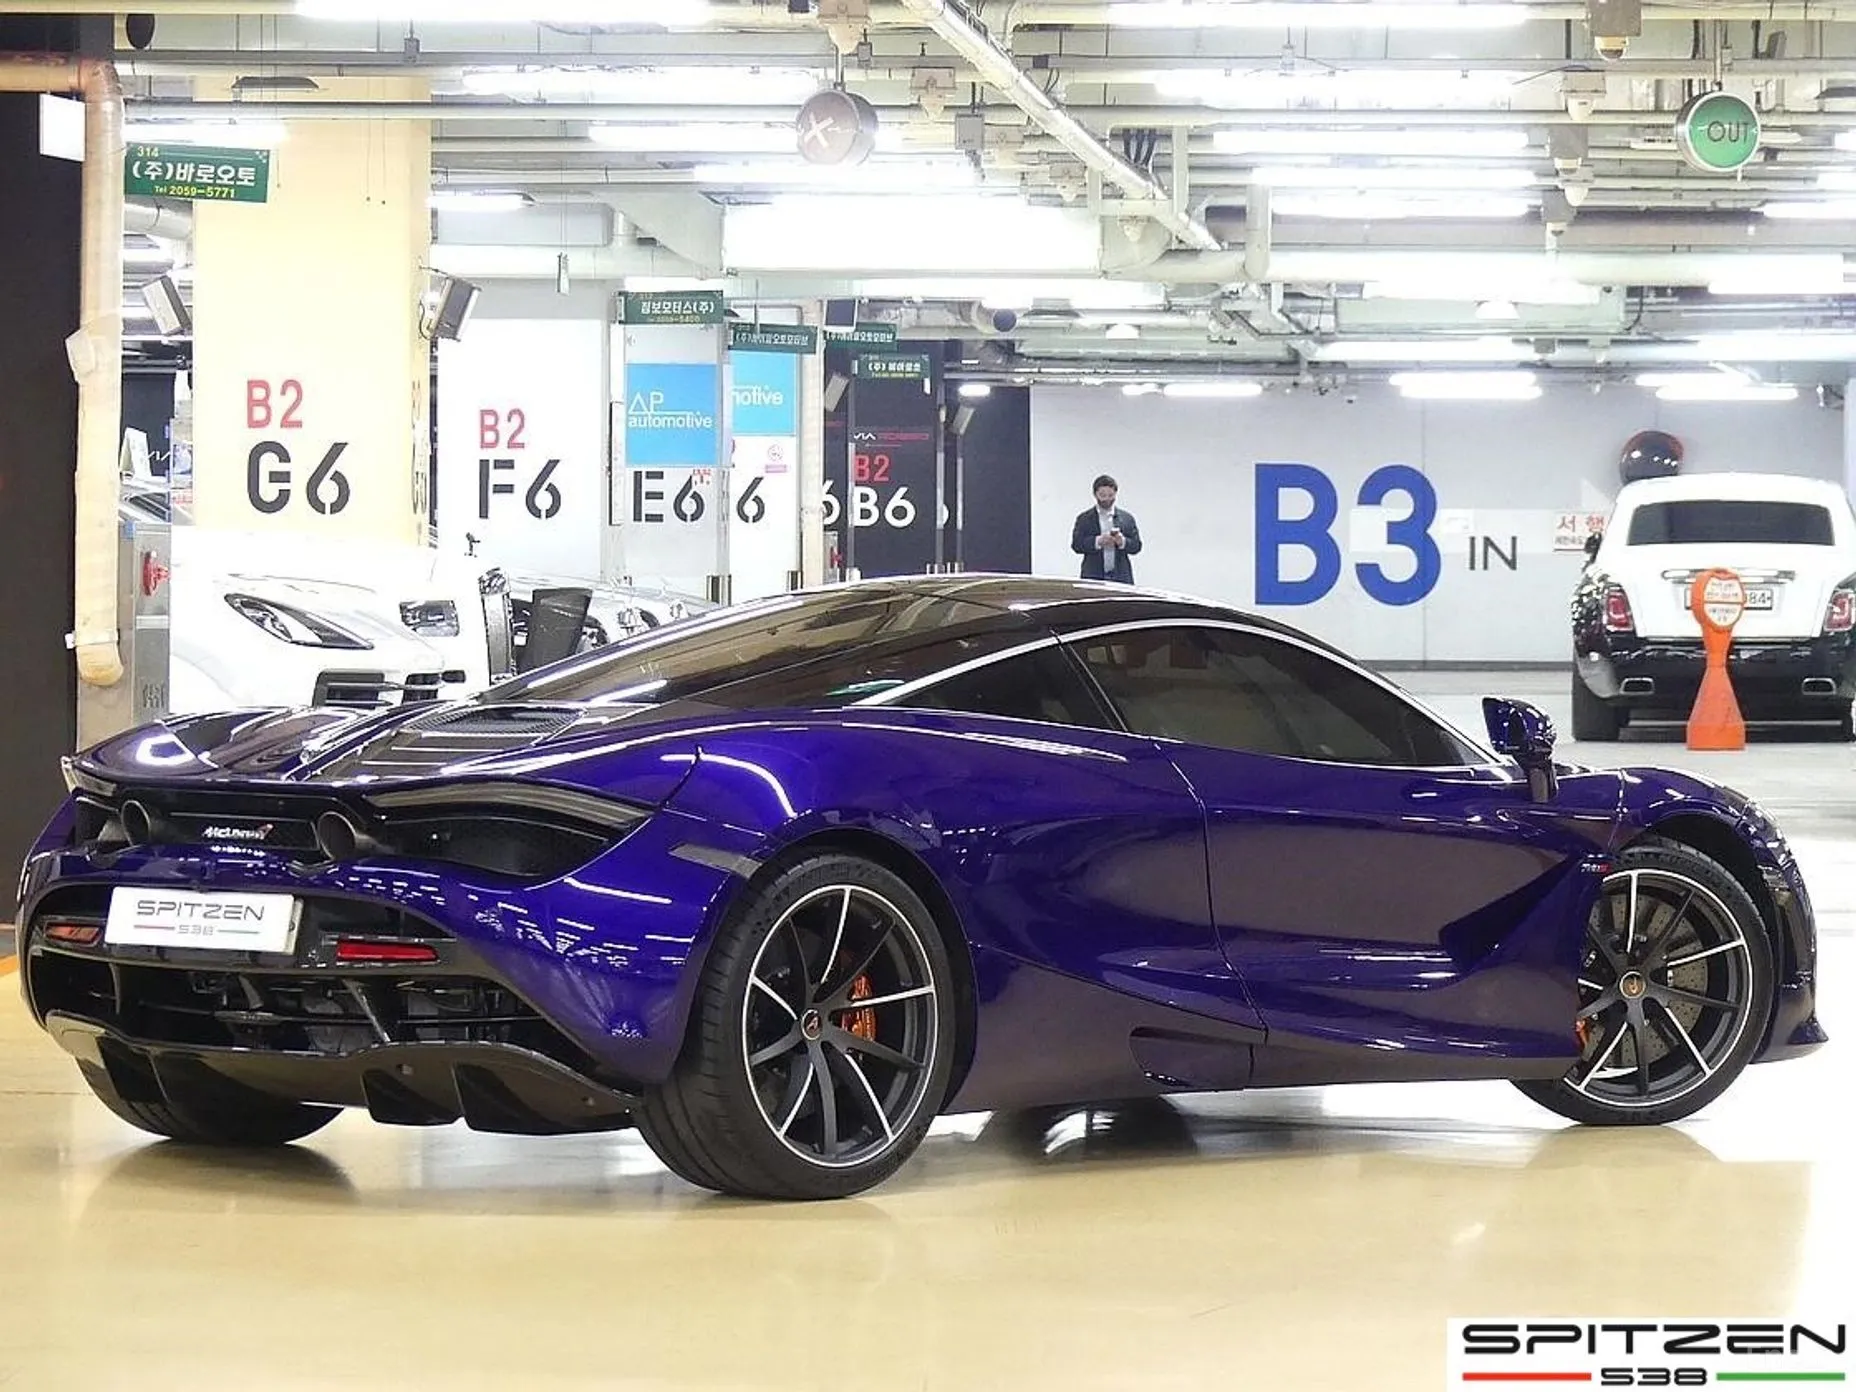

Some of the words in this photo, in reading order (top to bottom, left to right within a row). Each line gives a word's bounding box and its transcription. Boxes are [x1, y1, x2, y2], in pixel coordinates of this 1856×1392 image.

[1707, 120, 1749, 143] OUT
[137, 145, 159, 157] 314
[132, 160, 256, 187] (주)바로오토
[168, 185, 235, 198] 2059-5771
[247, 379, 303, 429] B2
[628, 411, 713, 428] automotive
[479, 408, 525, 449] B2
[247, 440, 351, 515] G6
[854, 454, 890, 482] B2
[479, 459, 562, 519] F6
[633, 470, 706, 523] E6
[852, 486, 917, 528] B6
[1254, 463, 1442, 607] B3
[1468, 536, 1518, 571] IN
[137, 900, 265, 921] SPITZEN
